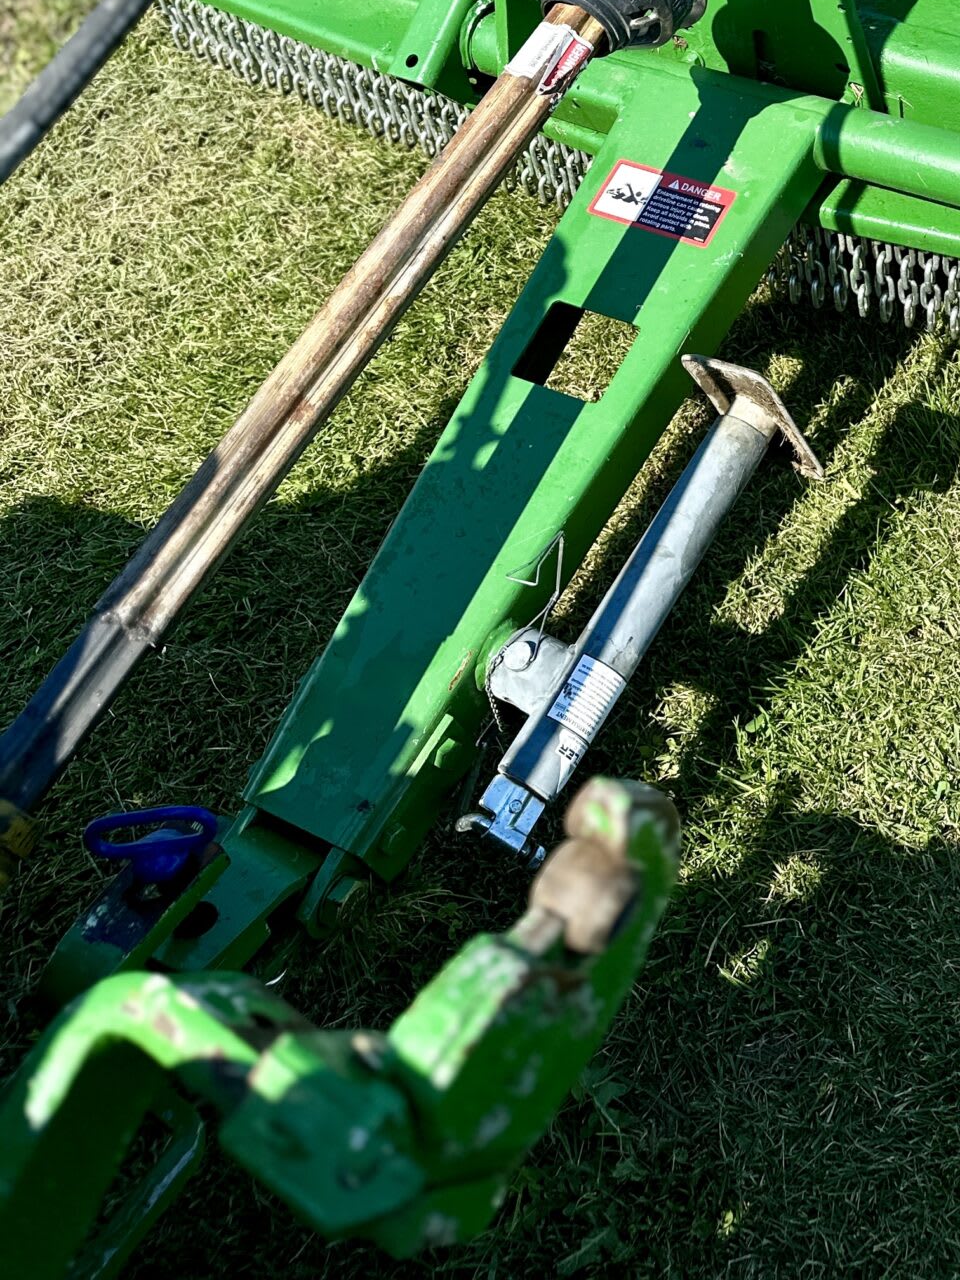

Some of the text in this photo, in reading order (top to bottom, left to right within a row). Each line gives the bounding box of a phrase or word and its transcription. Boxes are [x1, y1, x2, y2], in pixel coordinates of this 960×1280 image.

[656, 188, 694, 204] Entanglement
[681, 182, 722, 201] DANGER
[652, 194, 676, 205] driveline
[676, 201, 687, 209] can
[646, 205, 660, 215] Keep
[670, 205, 688, 216] injury
[639, 217, 661, 229] rotating
[642, 211, 659, 220] Avoid
[659, 216, 680, 226] contact
